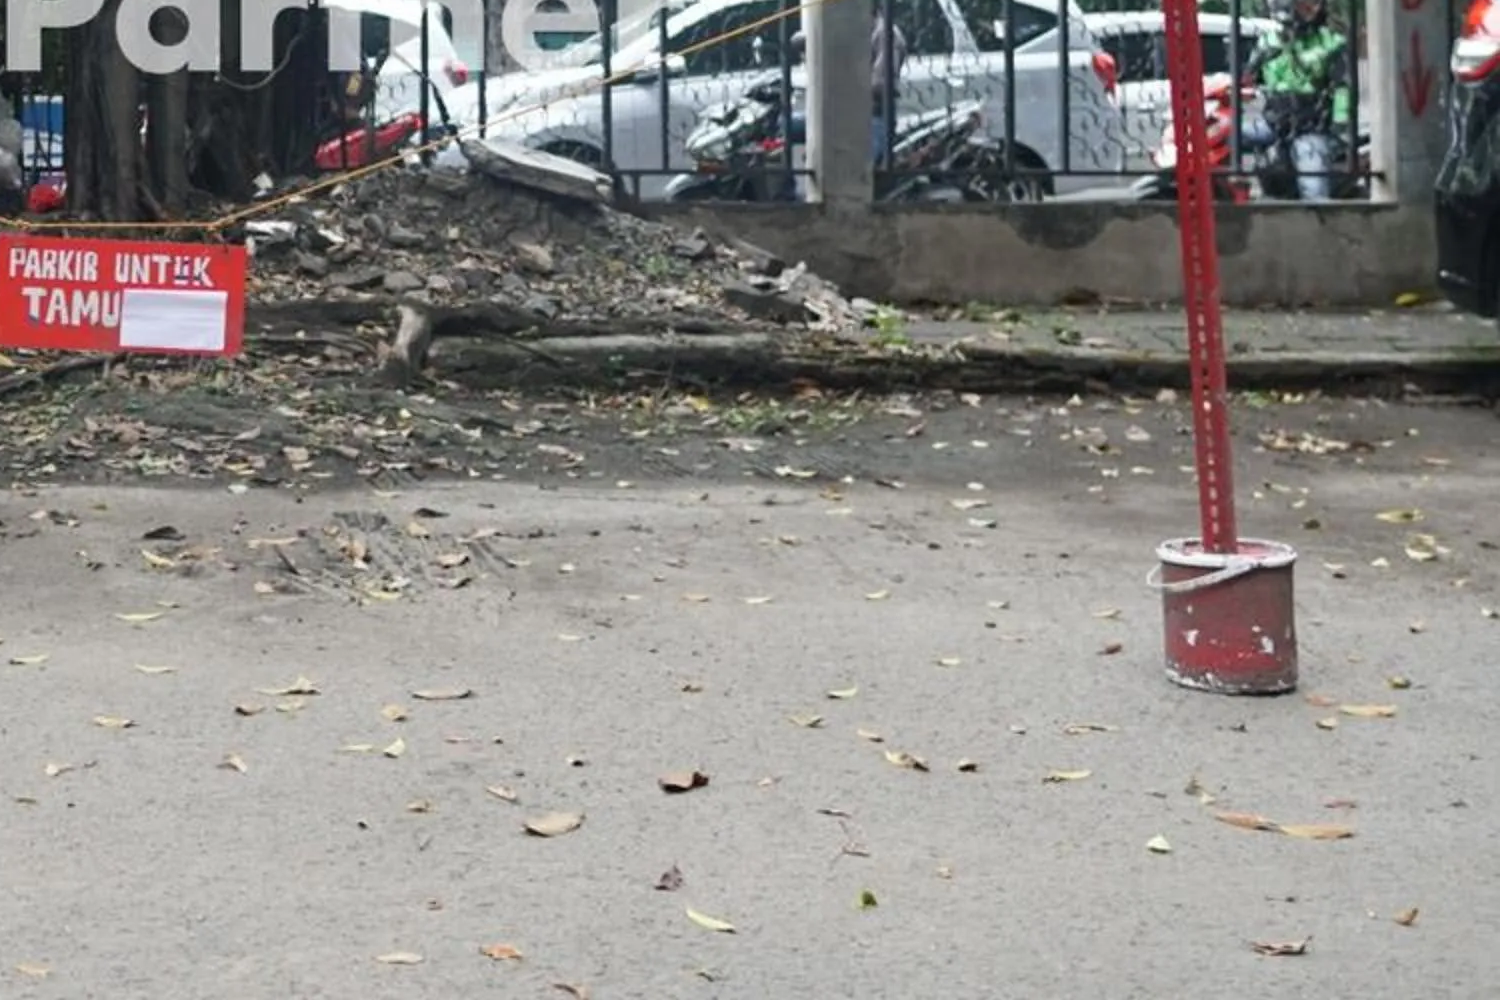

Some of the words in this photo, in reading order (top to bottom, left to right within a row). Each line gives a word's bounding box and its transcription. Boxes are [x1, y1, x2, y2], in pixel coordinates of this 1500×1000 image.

[9, 247, 98, 282] PARKIR
[115, 252, 214, 287] UNTUK
[21, 287, 120, 327] TAMU
